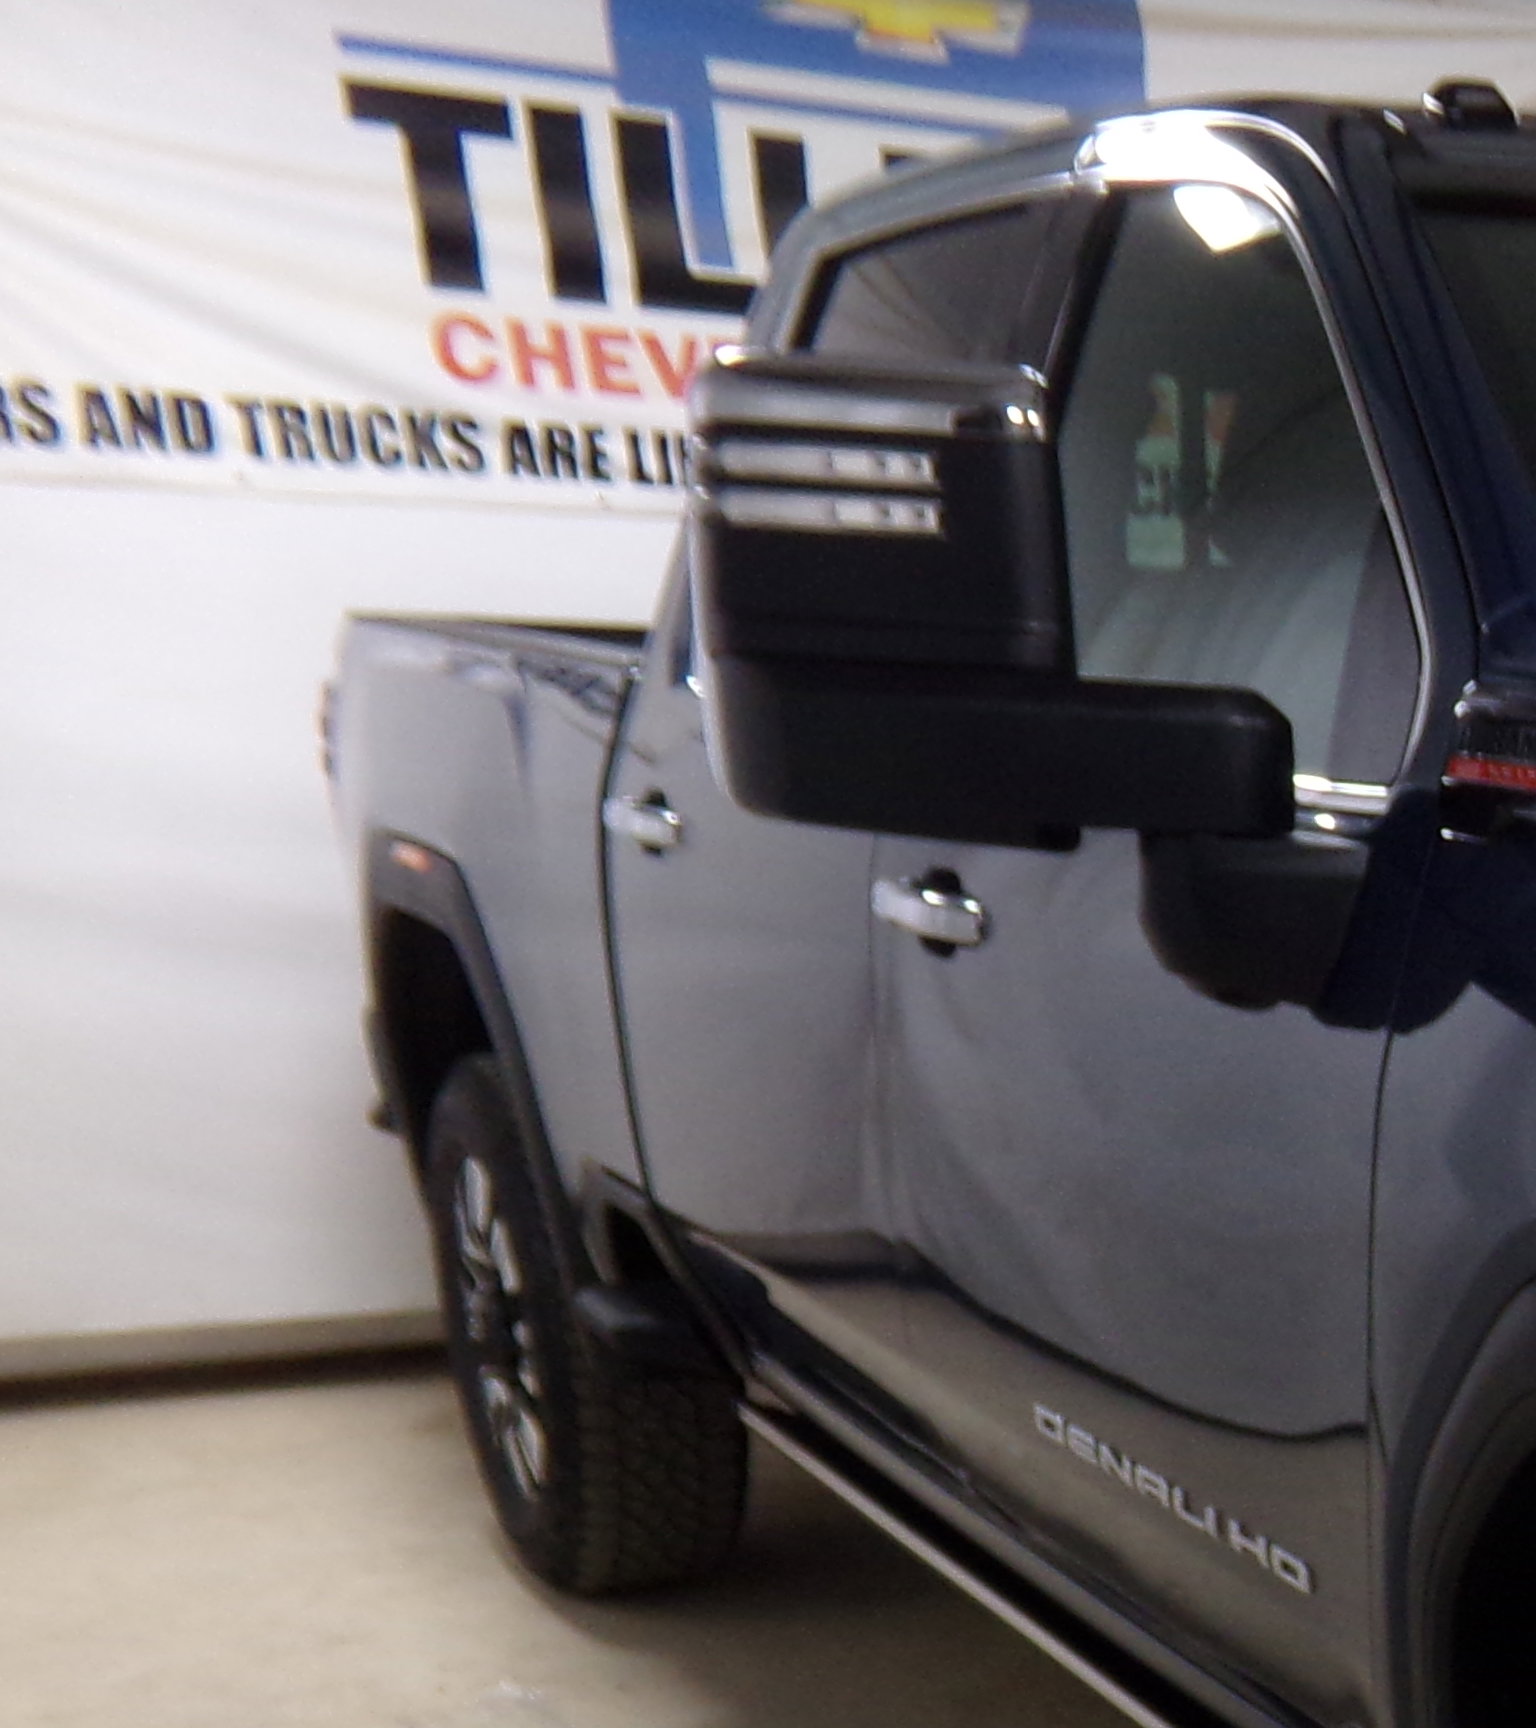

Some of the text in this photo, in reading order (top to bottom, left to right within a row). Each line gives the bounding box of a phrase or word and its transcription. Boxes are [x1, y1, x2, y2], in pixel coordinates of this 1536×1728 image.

[430, 310, 742, 398] CHEV
[75, 381, 216, 454] AND
[224, 392, 486, 474] TRUCKS
[498, 416, 608, 482] ARE
[620, 425, 692, 487] LI
[1032, 1402, 1314, 1595] DENALI HD
